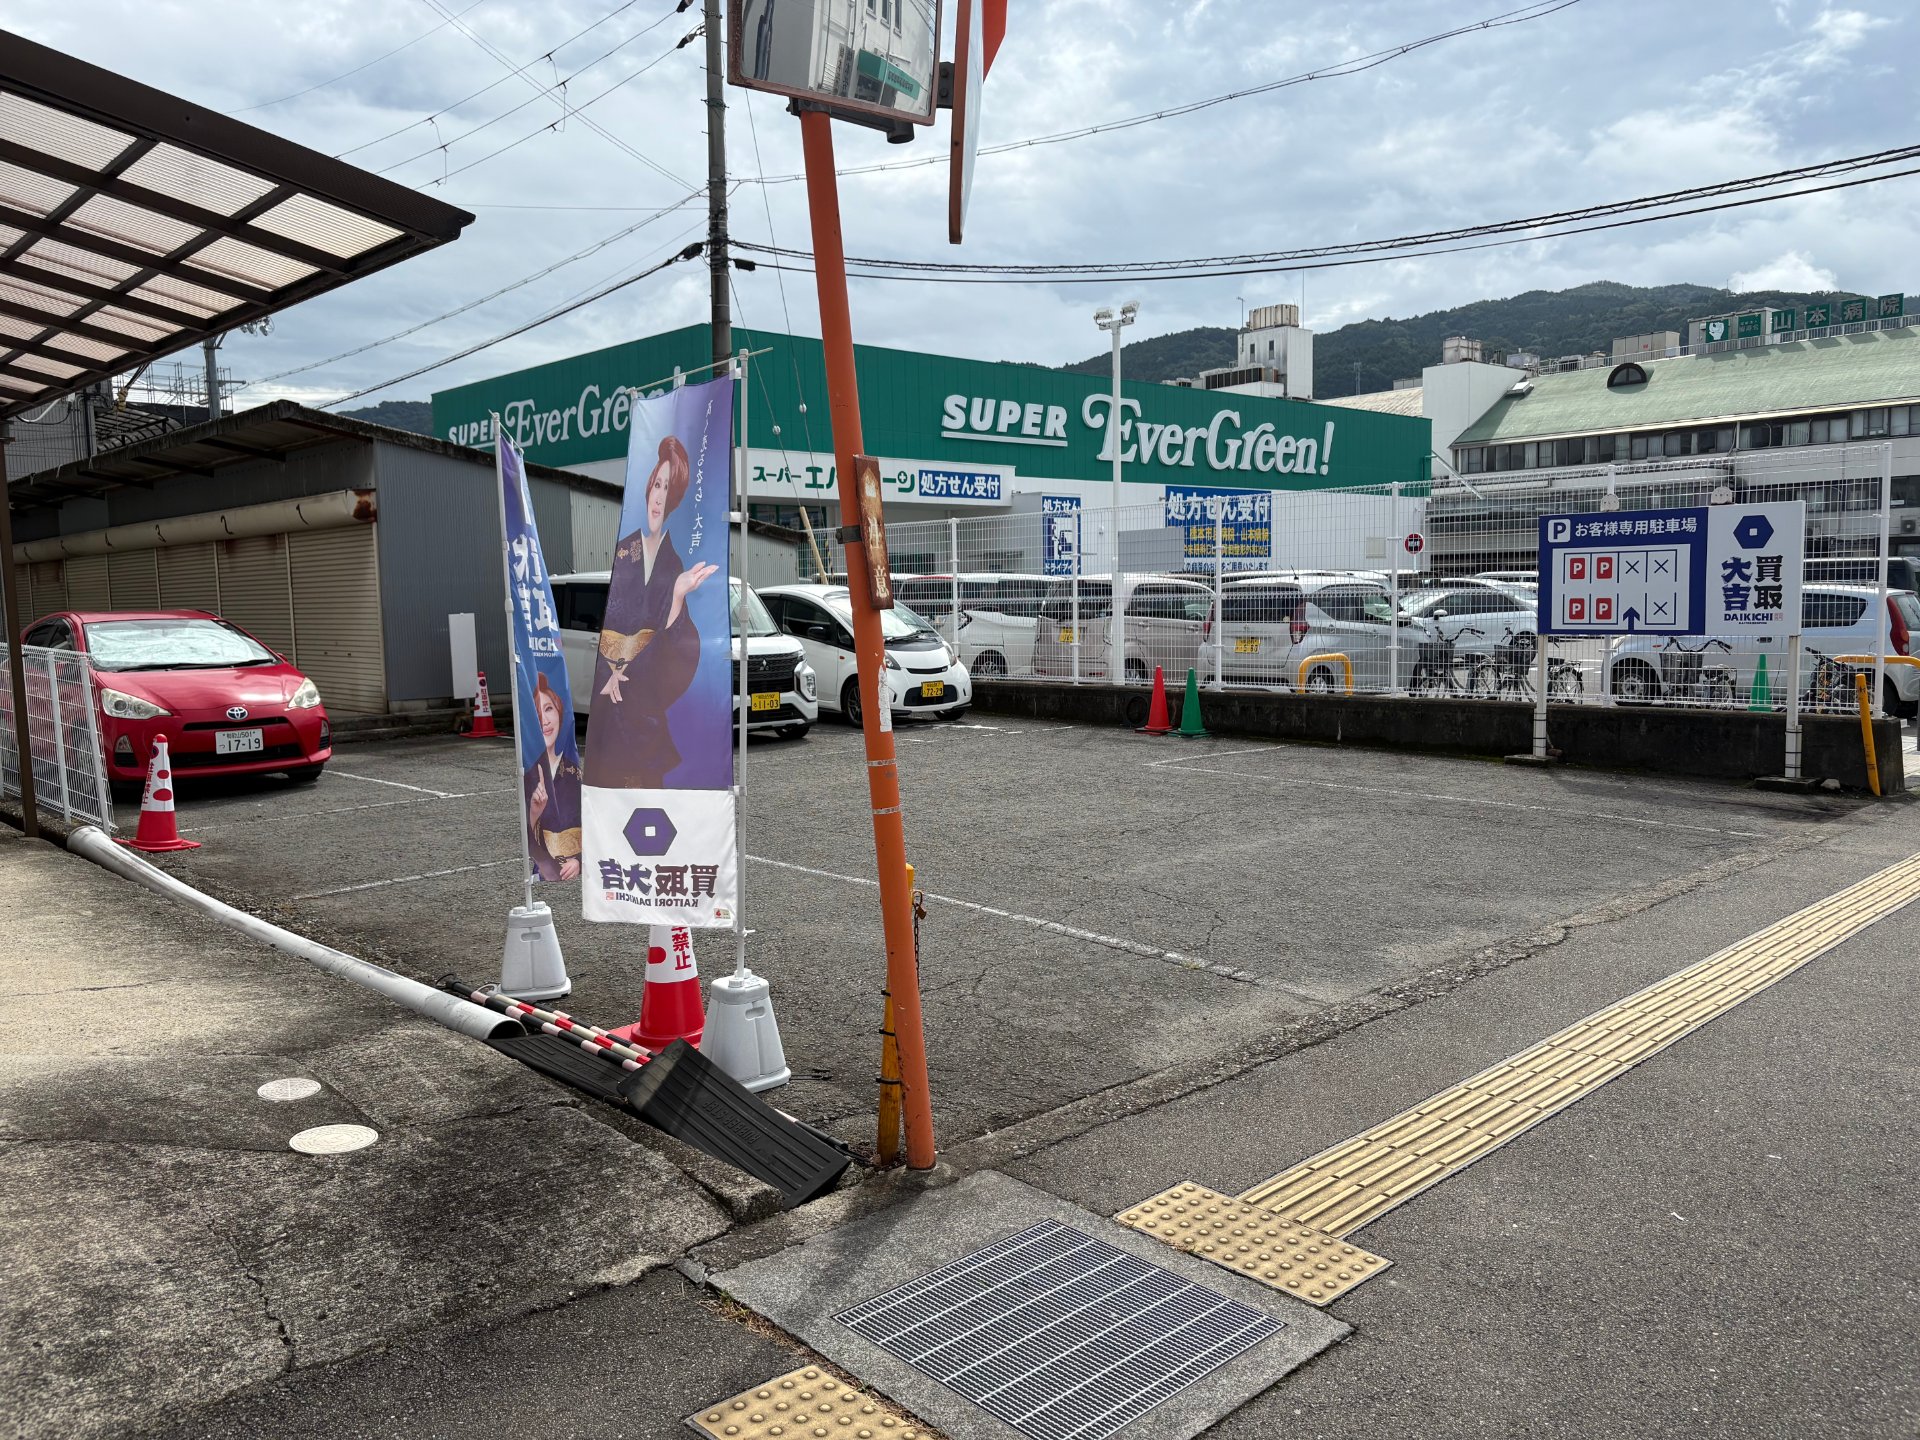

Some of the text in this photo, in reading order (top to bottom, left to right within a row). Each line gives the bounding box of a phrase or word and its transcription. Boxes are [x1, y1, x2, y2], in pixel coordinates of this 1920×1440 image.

[1774, 297, 1900, 331] 山本病院
[941, 393, 1335, 476] SUPER EverGreen!
[753, 465, 802, 484] スーパー
[920, 472, 1000, 498] 処方せん受付
[1168, 491, 1270, 522] 処方せん受付
[1553, 517, 1697, 540] P お客様専用駐車場
[1724, 612, 1773, 621] DAIKICHI
[228, 738, 261, 751] 17-19
[671, 926, 691, 971] 禁止
